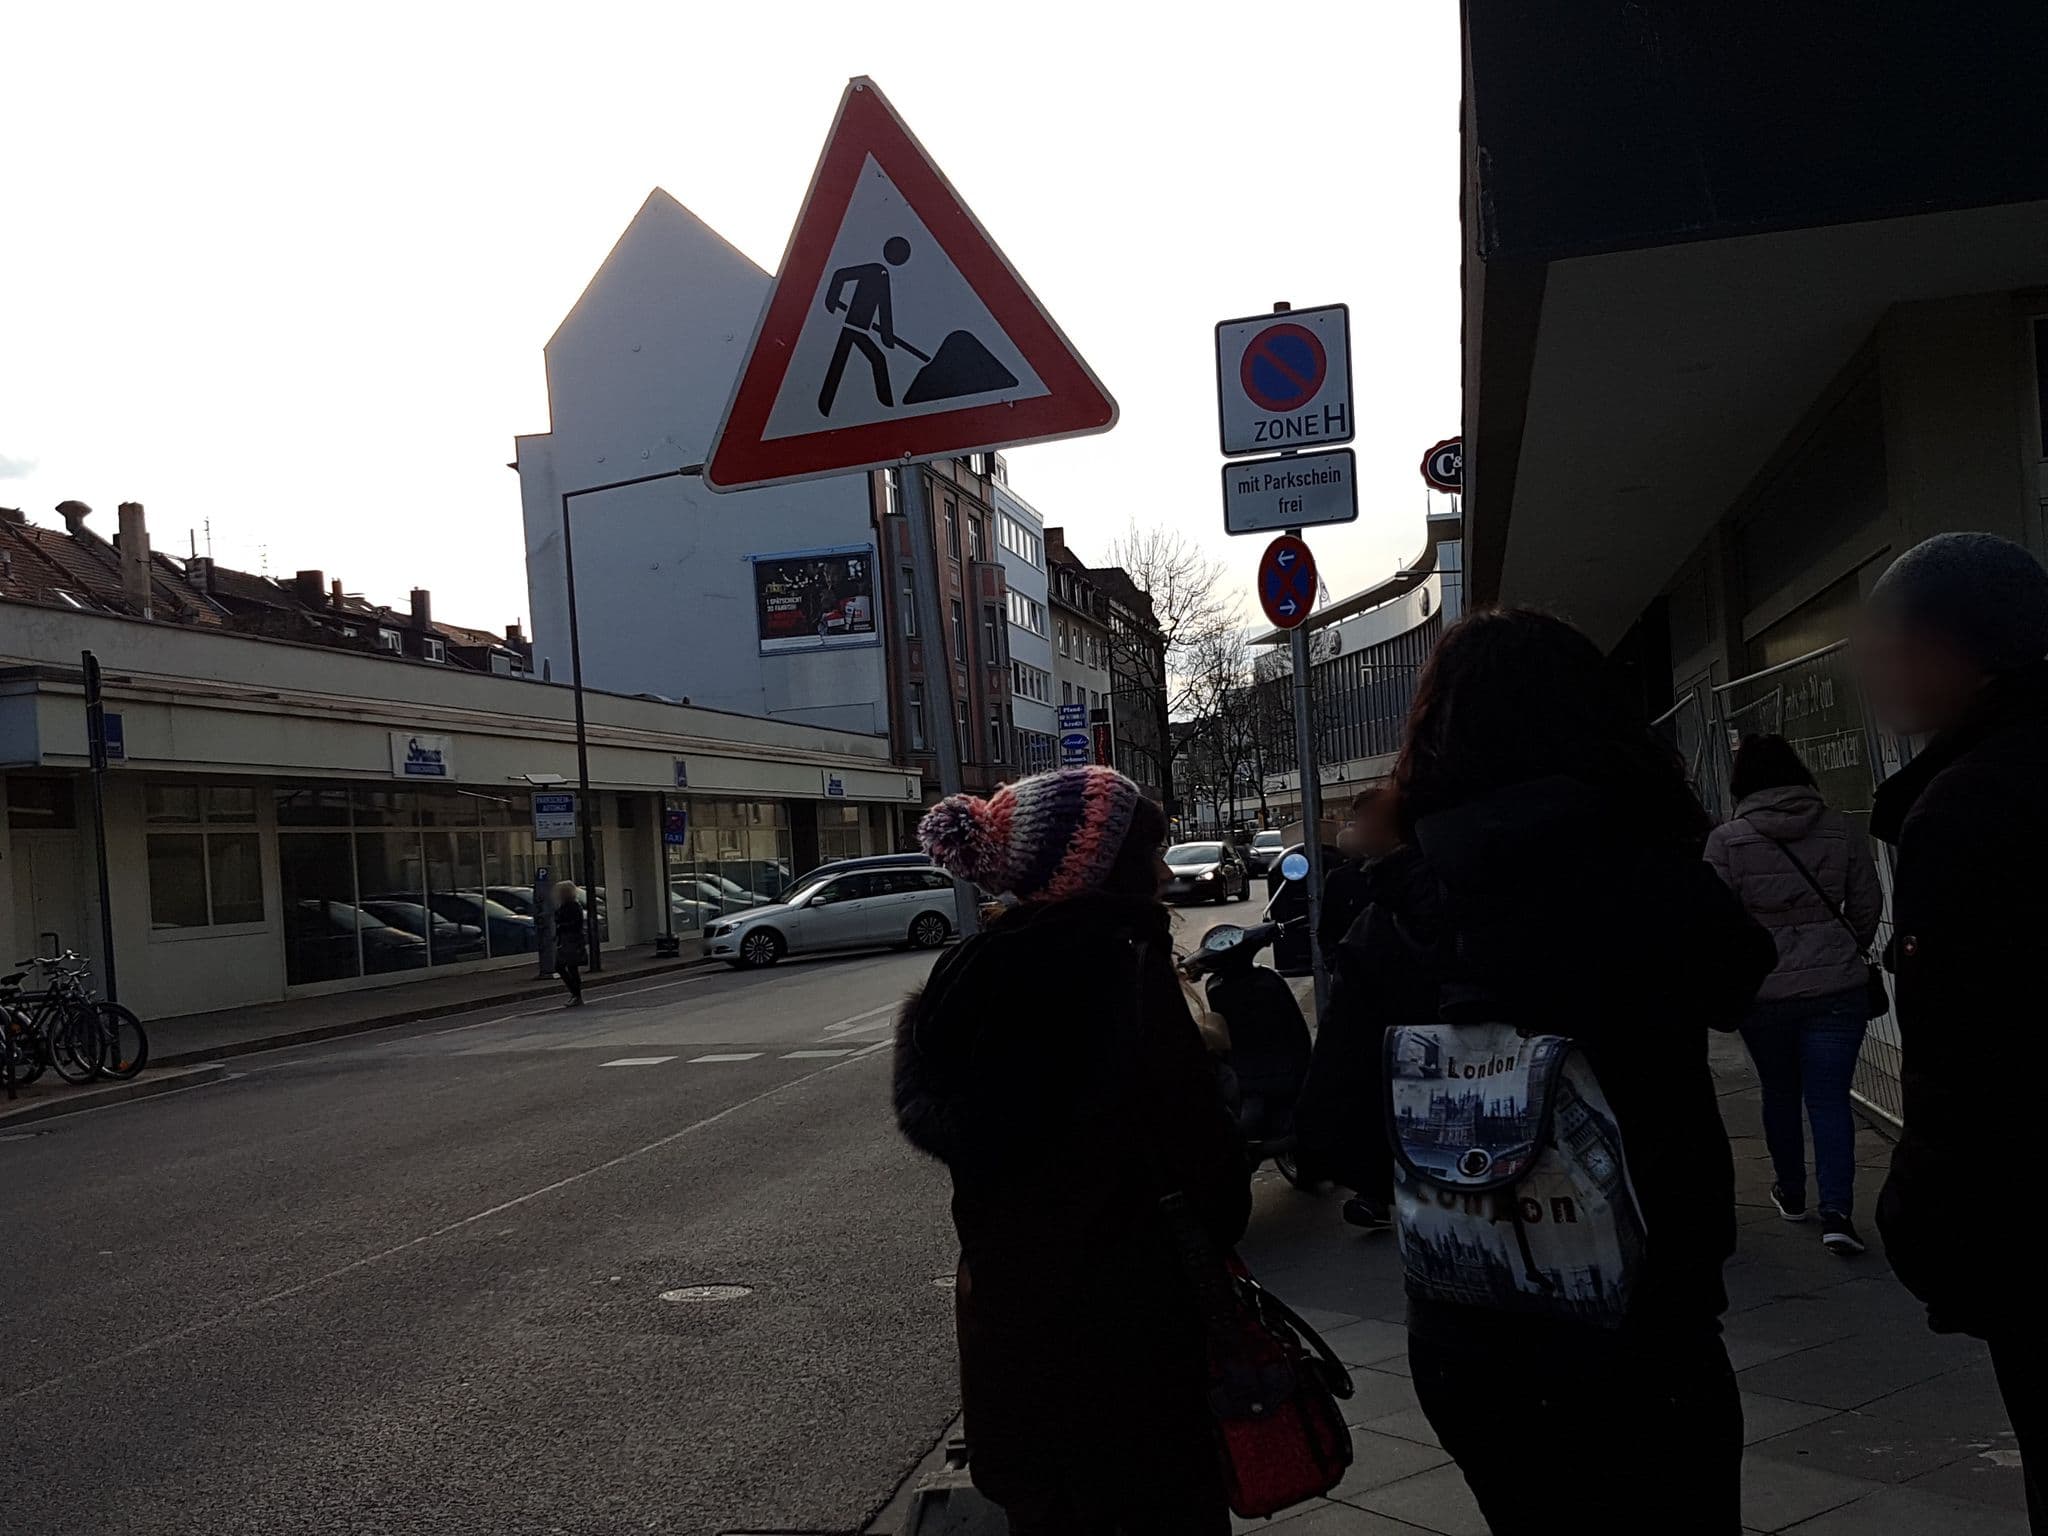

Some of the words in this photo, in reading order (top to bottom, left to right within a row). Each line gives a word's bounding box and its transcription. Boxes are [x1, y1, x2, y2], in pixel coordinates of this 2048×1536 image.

[1436, 452, 1462, 477] C&
[1238, 476, 1260, 494] mit
[1264, 466, 1341, 491] Parkschein
[1278, 495, 1304, 514] frei
[539, 868, 548, 879] P
[1448, 1055, 1515, 1080] London
